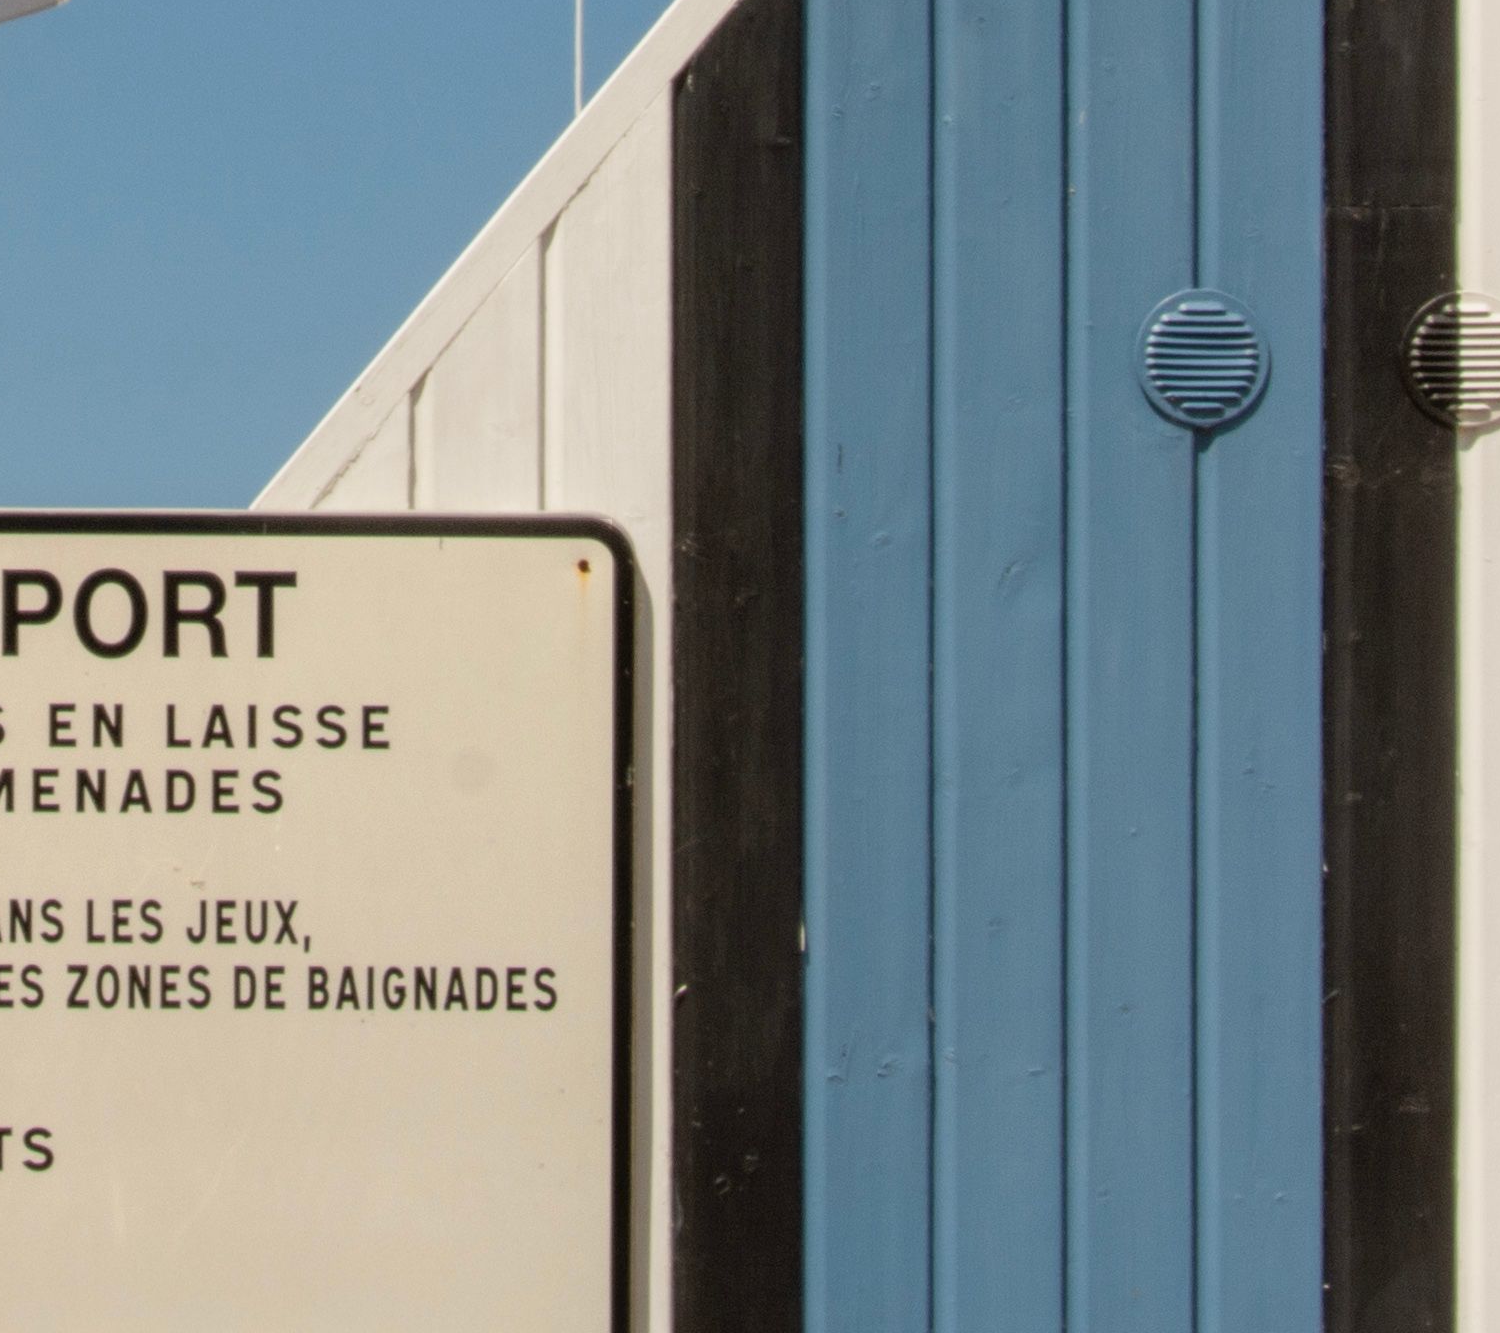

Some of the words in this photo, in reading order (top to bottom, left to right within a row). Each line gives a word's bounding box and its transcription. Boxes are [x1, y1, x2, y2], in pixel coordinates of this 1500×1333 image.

[49, 704, 123, 748] EN
[167, 704, 390, 750] LAISSE
[87, 900, 163, 944] LES
[186, 900, 310, 953] JEUX,
[67, 965, 211, 1010] ZONES
[234, 966, 285, 1010] DE
[308, 966, 557, 1012] BAIGNADES
